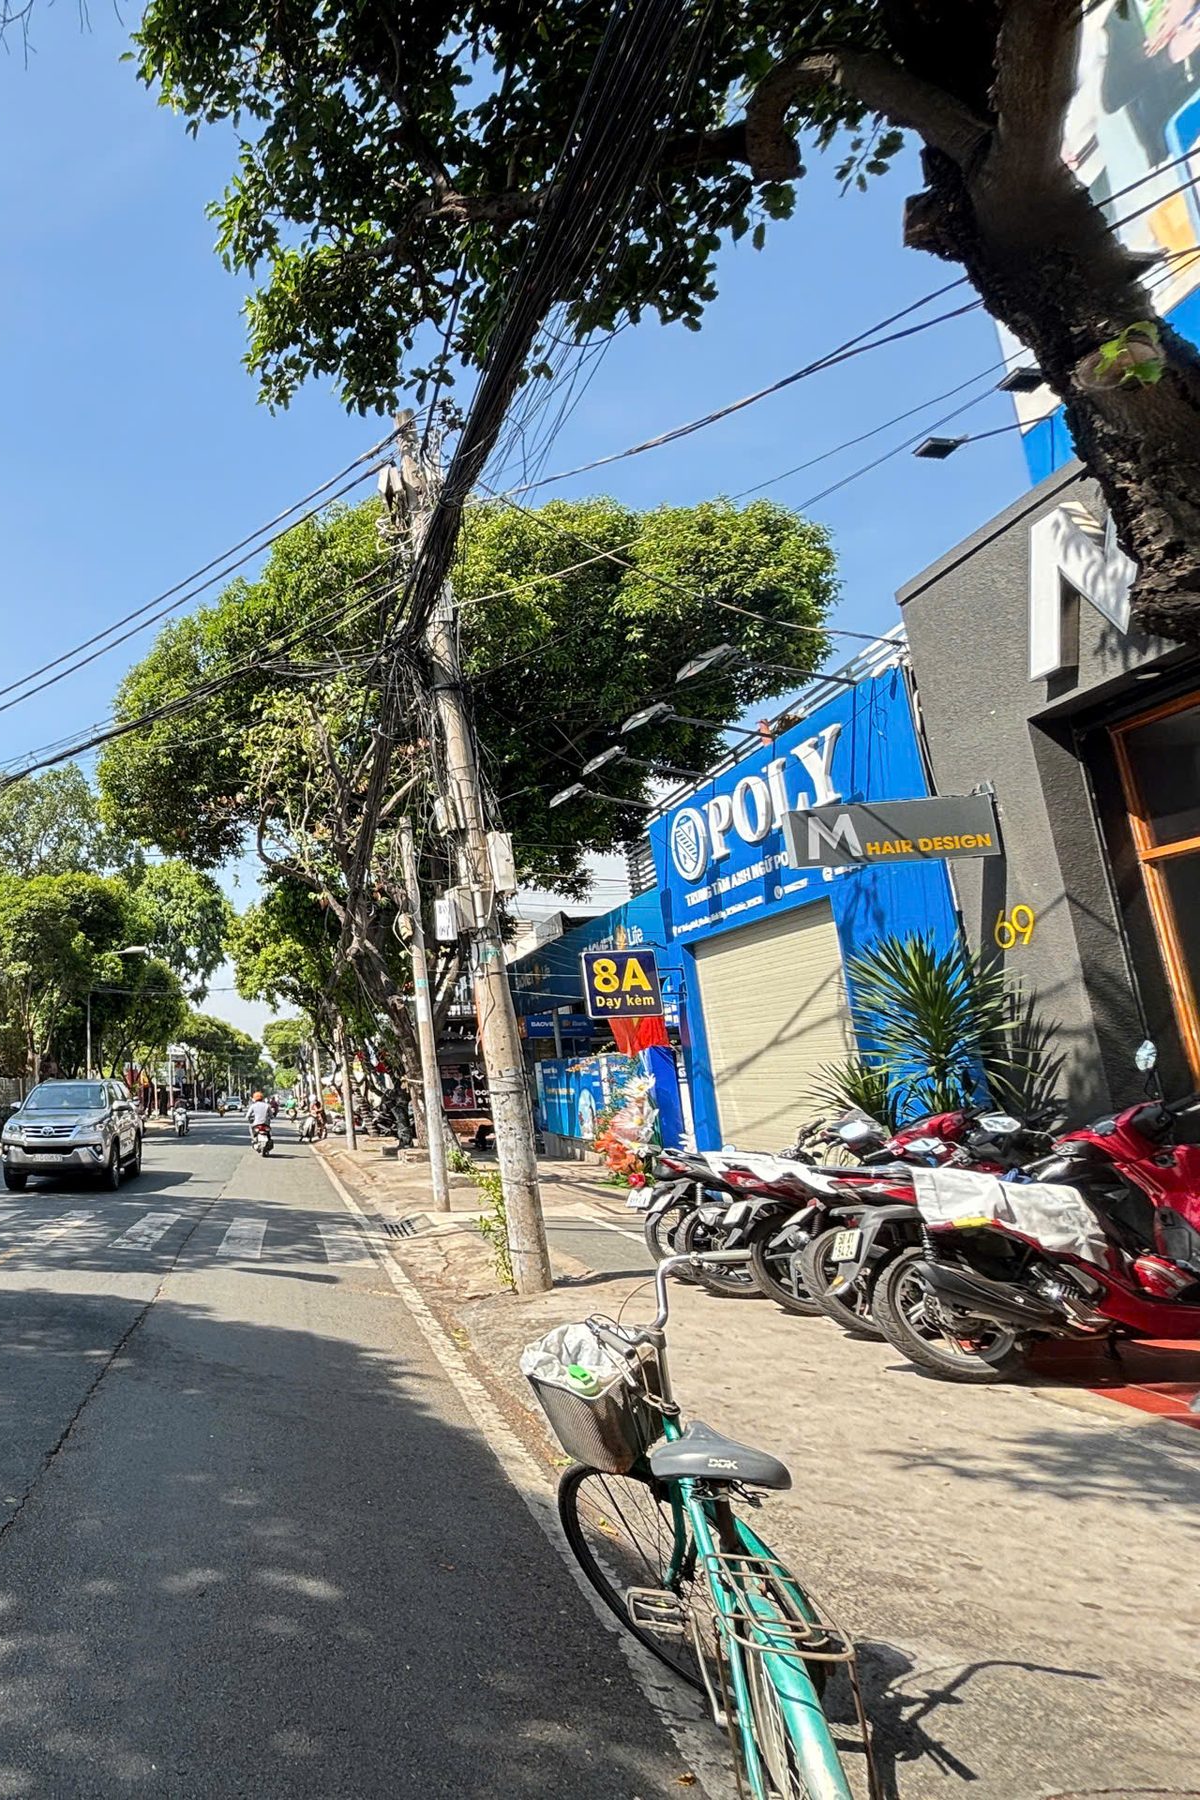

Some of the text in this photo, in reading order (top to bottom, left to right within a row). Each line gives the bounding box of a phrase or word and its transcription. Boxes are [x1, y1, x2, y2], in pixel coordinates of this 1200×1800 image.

[702, 722, 842, 861] POLY
[807, 813, 865, 860] M
[866, 832, 993, 857] HAIR DESIGN
[994, 904, 1035, 949] 69
[592, 957, 653, 993] 8A
[595, 993, 655, 1010] Dạy kèm
